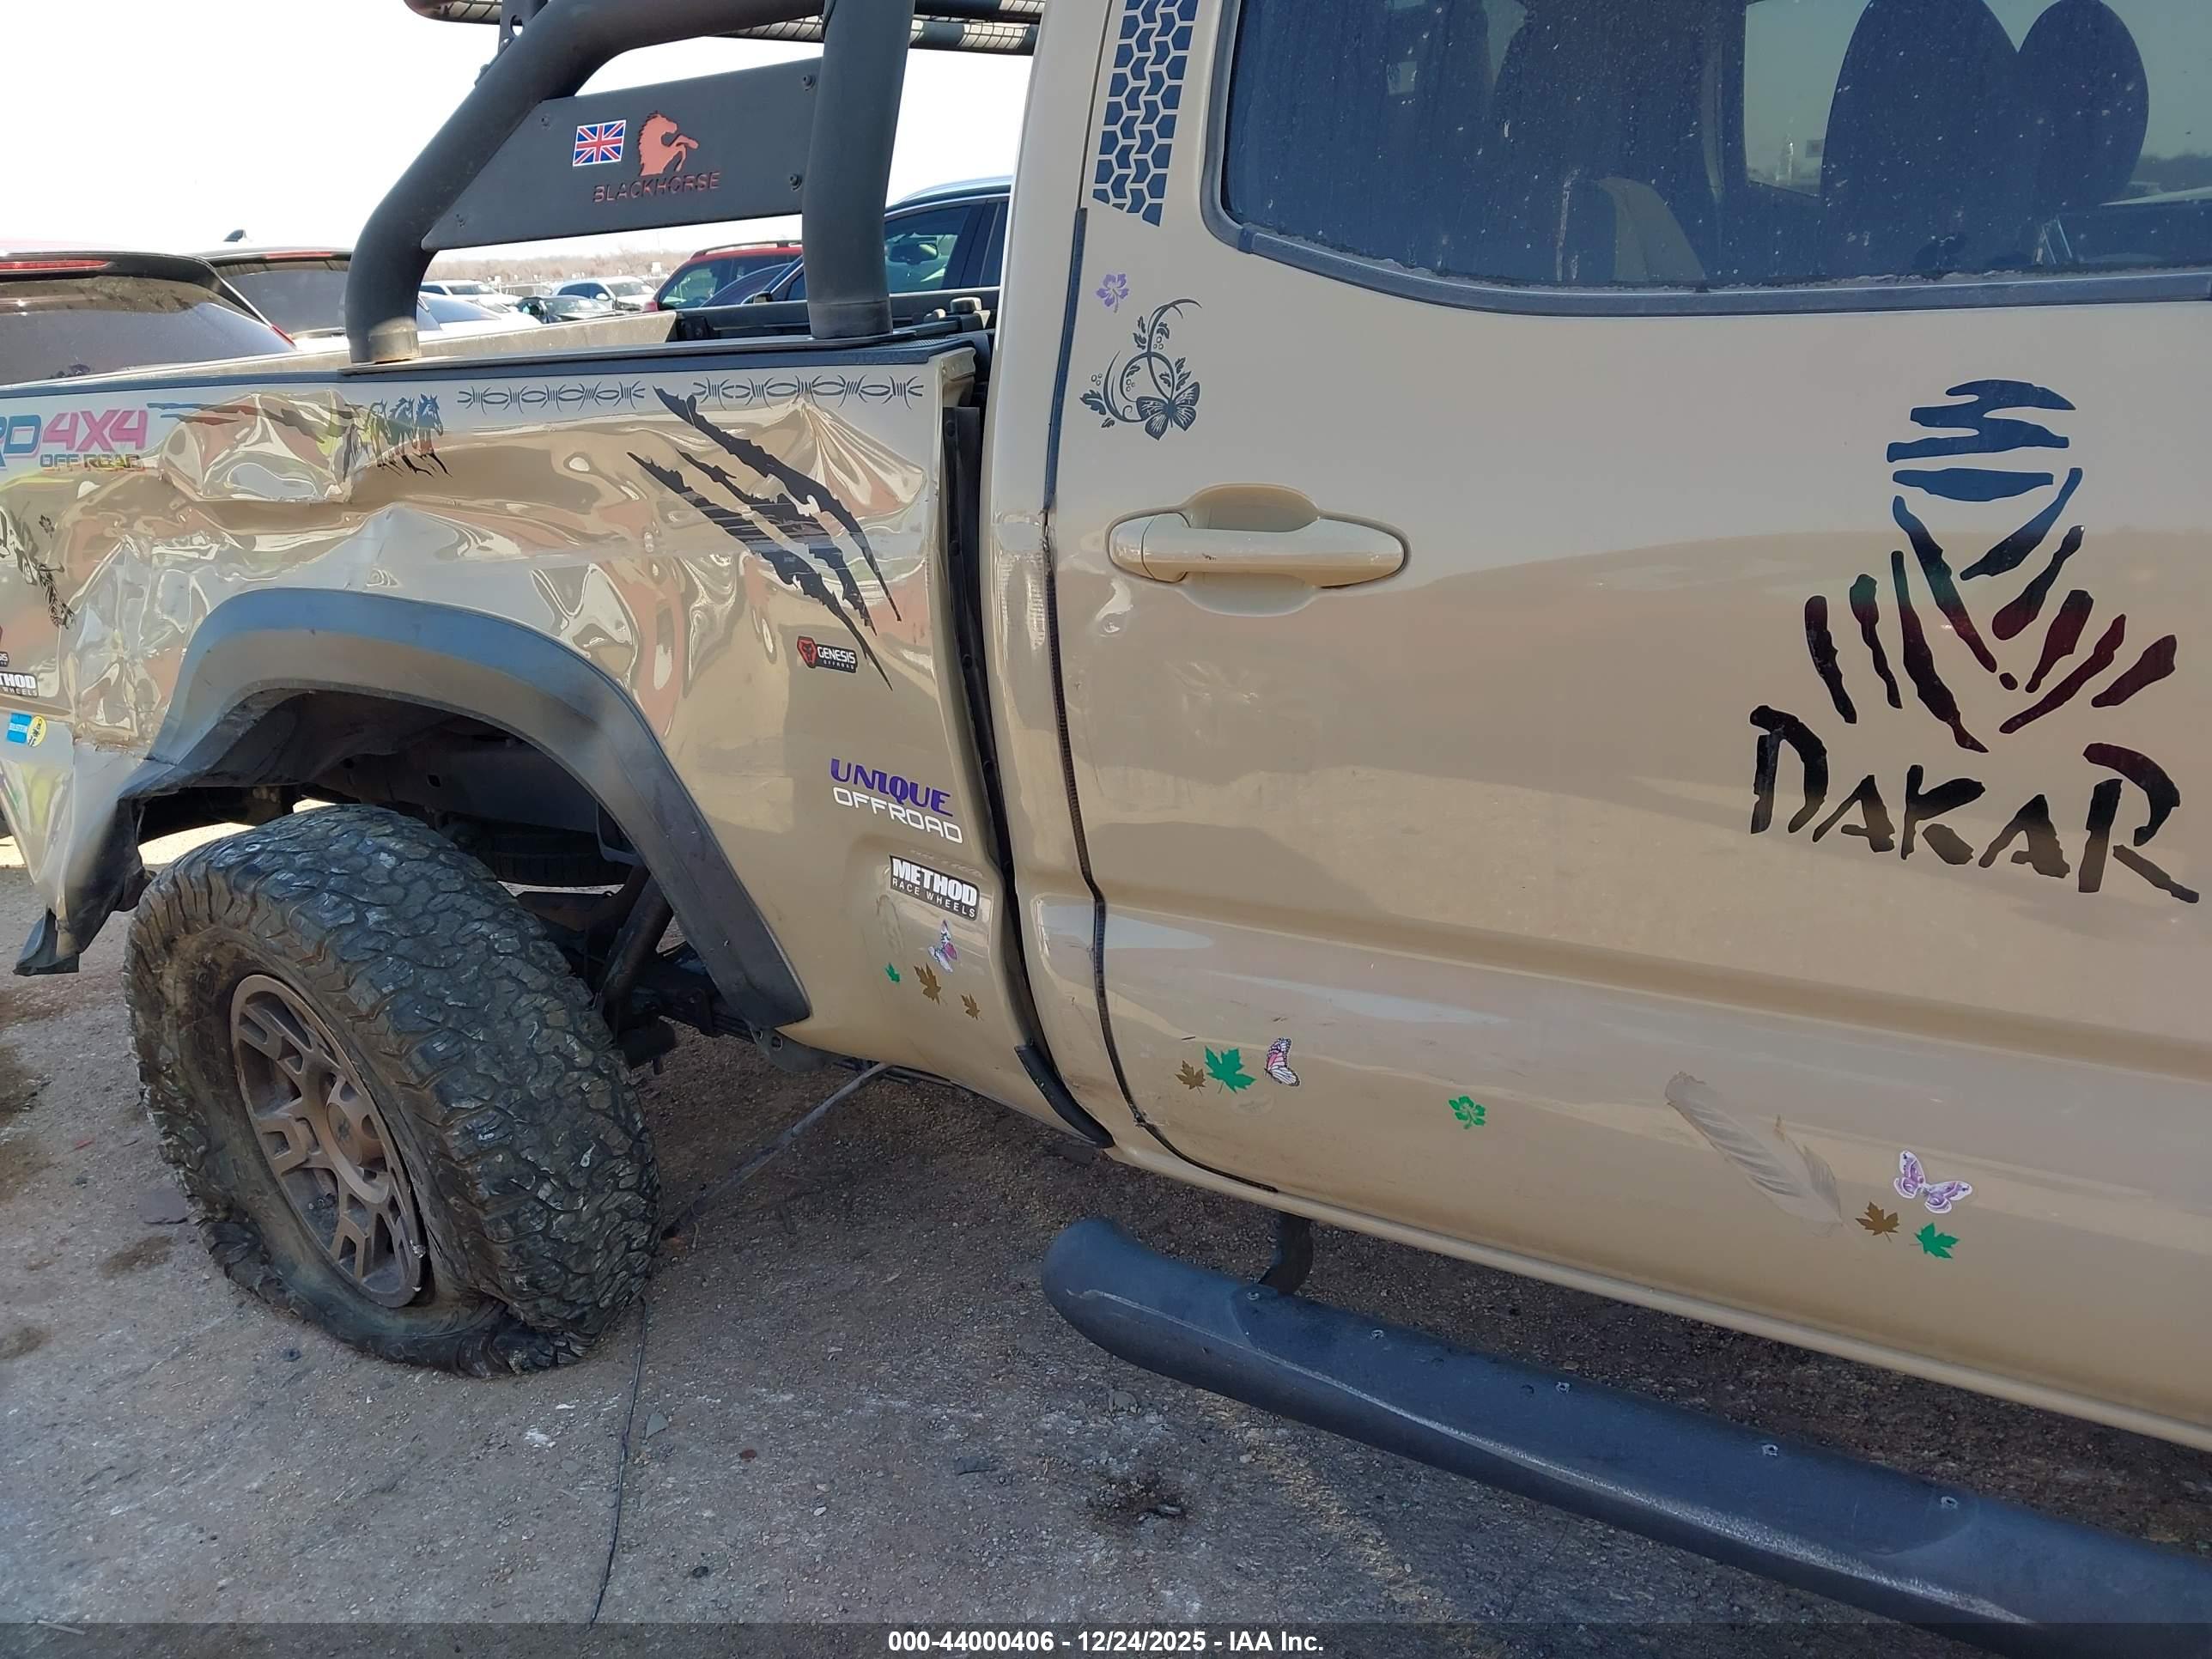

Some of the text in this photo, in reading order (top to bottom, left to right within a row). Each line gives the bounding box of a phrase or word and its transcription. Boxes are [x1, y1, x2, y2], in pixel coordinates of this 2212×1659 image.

[592, 172, 720, 203] BLACKHORSE
[43, 409, 149, 453] 4X4
[40, 453, 80, 470] OFF
[817, 646, 856, 664] GENESIS
[830, 757, 954, 817] UNIQUE
[1749, 705, 2200, 904] DAKAR
[832, 786, 963, 844] OFFROAD
[892, 857, 978, 907] METHOD
[892, 877, 976, 919] RACE WHEELS
